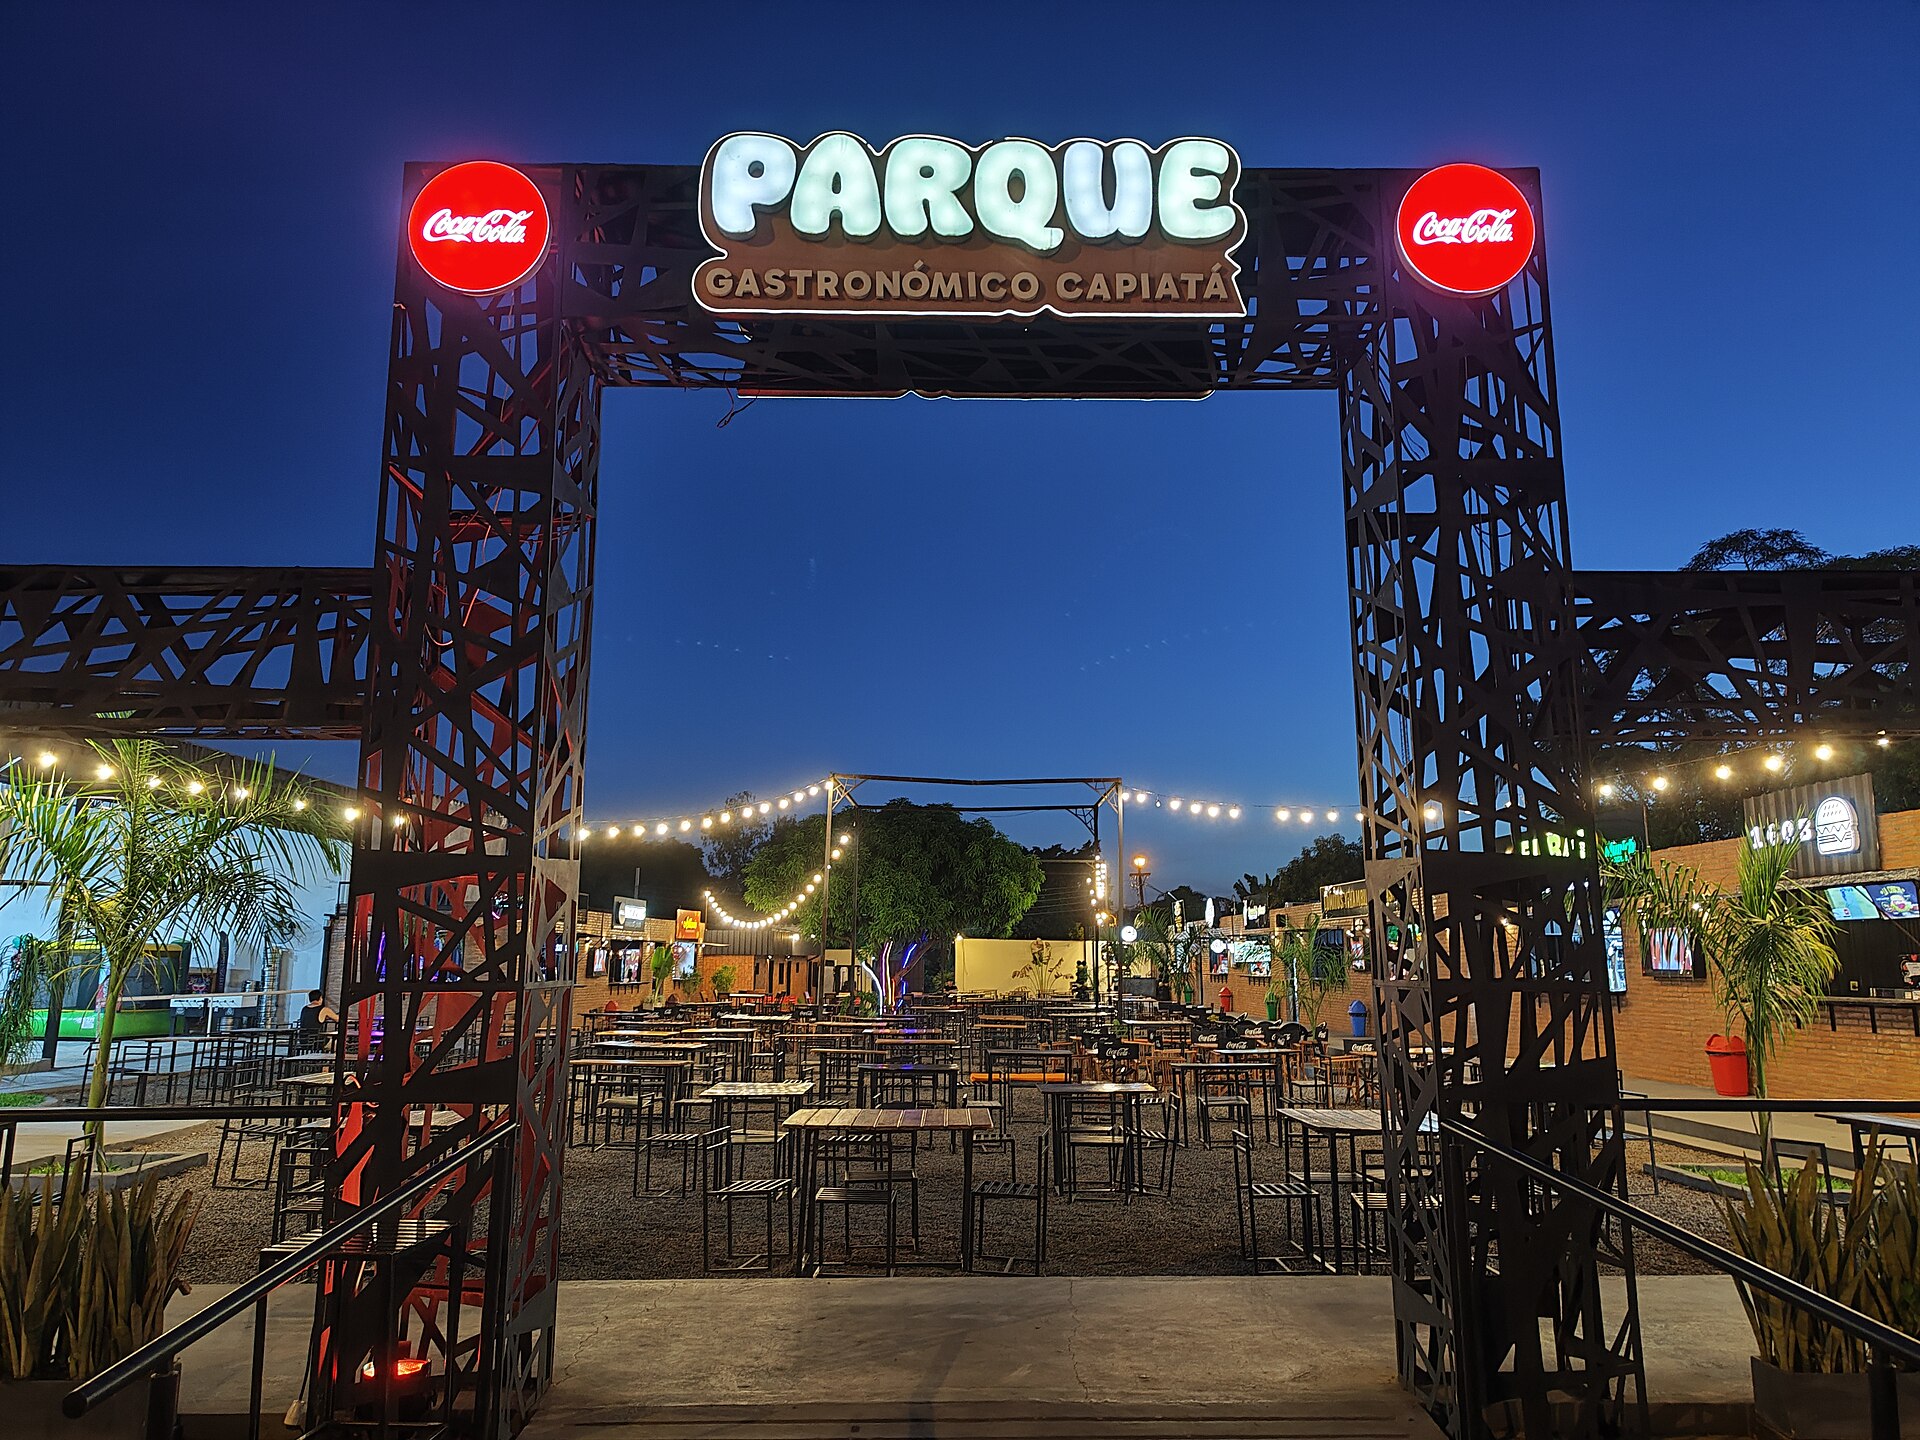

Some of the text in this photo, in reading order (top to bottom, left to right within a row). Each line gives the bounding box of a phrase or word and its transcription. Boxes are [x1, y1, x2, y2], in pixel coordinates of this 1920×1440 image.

[711, 133, 1237, 251] PARQUE
[422, 208, 534, 243] Coca-Cola
[1412, 208, 1518, 245] Coca-Cola
[705, 260, 1229, 301] GASTRONÓMICO CAPIATÁ
